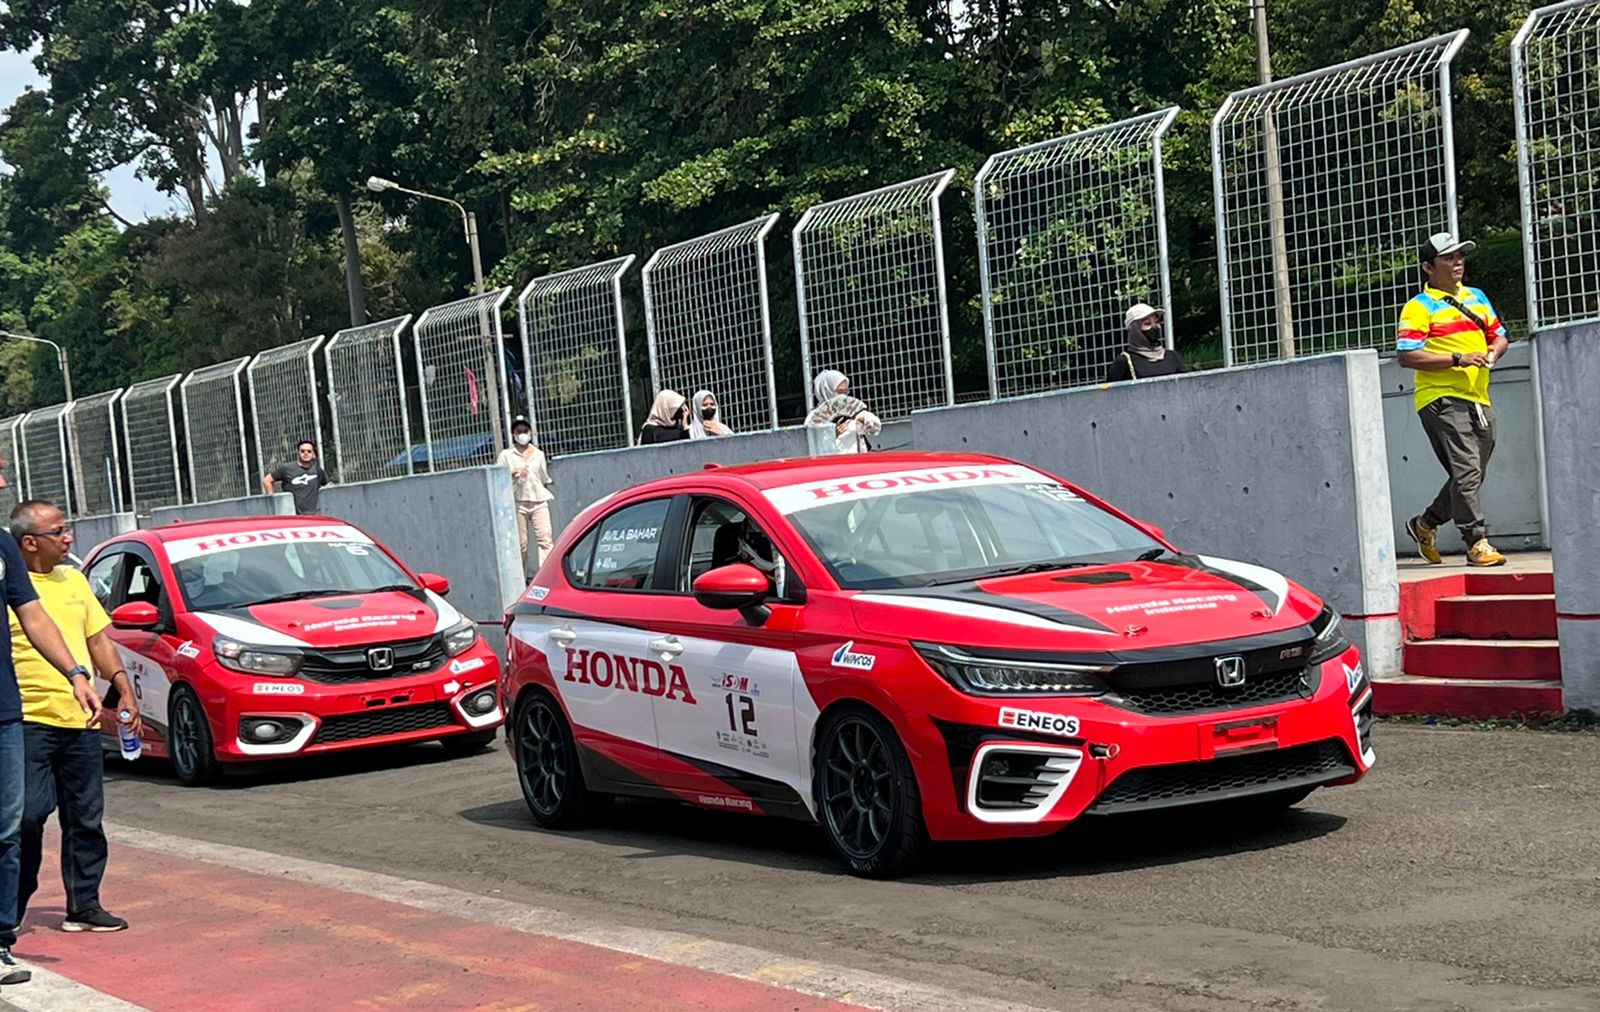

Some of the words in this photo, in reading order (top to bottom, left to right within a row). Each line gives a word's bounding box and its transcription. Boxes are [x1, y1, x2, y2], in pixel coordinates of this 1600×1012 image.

[807, 468, 1019, 500] HONDA
[1037, 489, 1087, 502] 12
[195, 530, 347, 551] HONDA
[601, 529, 625, 542] AVILA
[625, 527, 658, 540] BAHAR
[1105, 598, 1170, 615] Honda
[1172, 593, 1238, 606] Racing
[1144, 601, 1218, 615] Indonesia
[133, 674, 143, 701] 6
[563, 647, 698, 706] HONDA
[725, 692, 758, 737] 12
[1016, 712, 1078, 734] ENEOS
[698, 794, 725, 806] Honda
[725, 796, 753, 811] Racing
